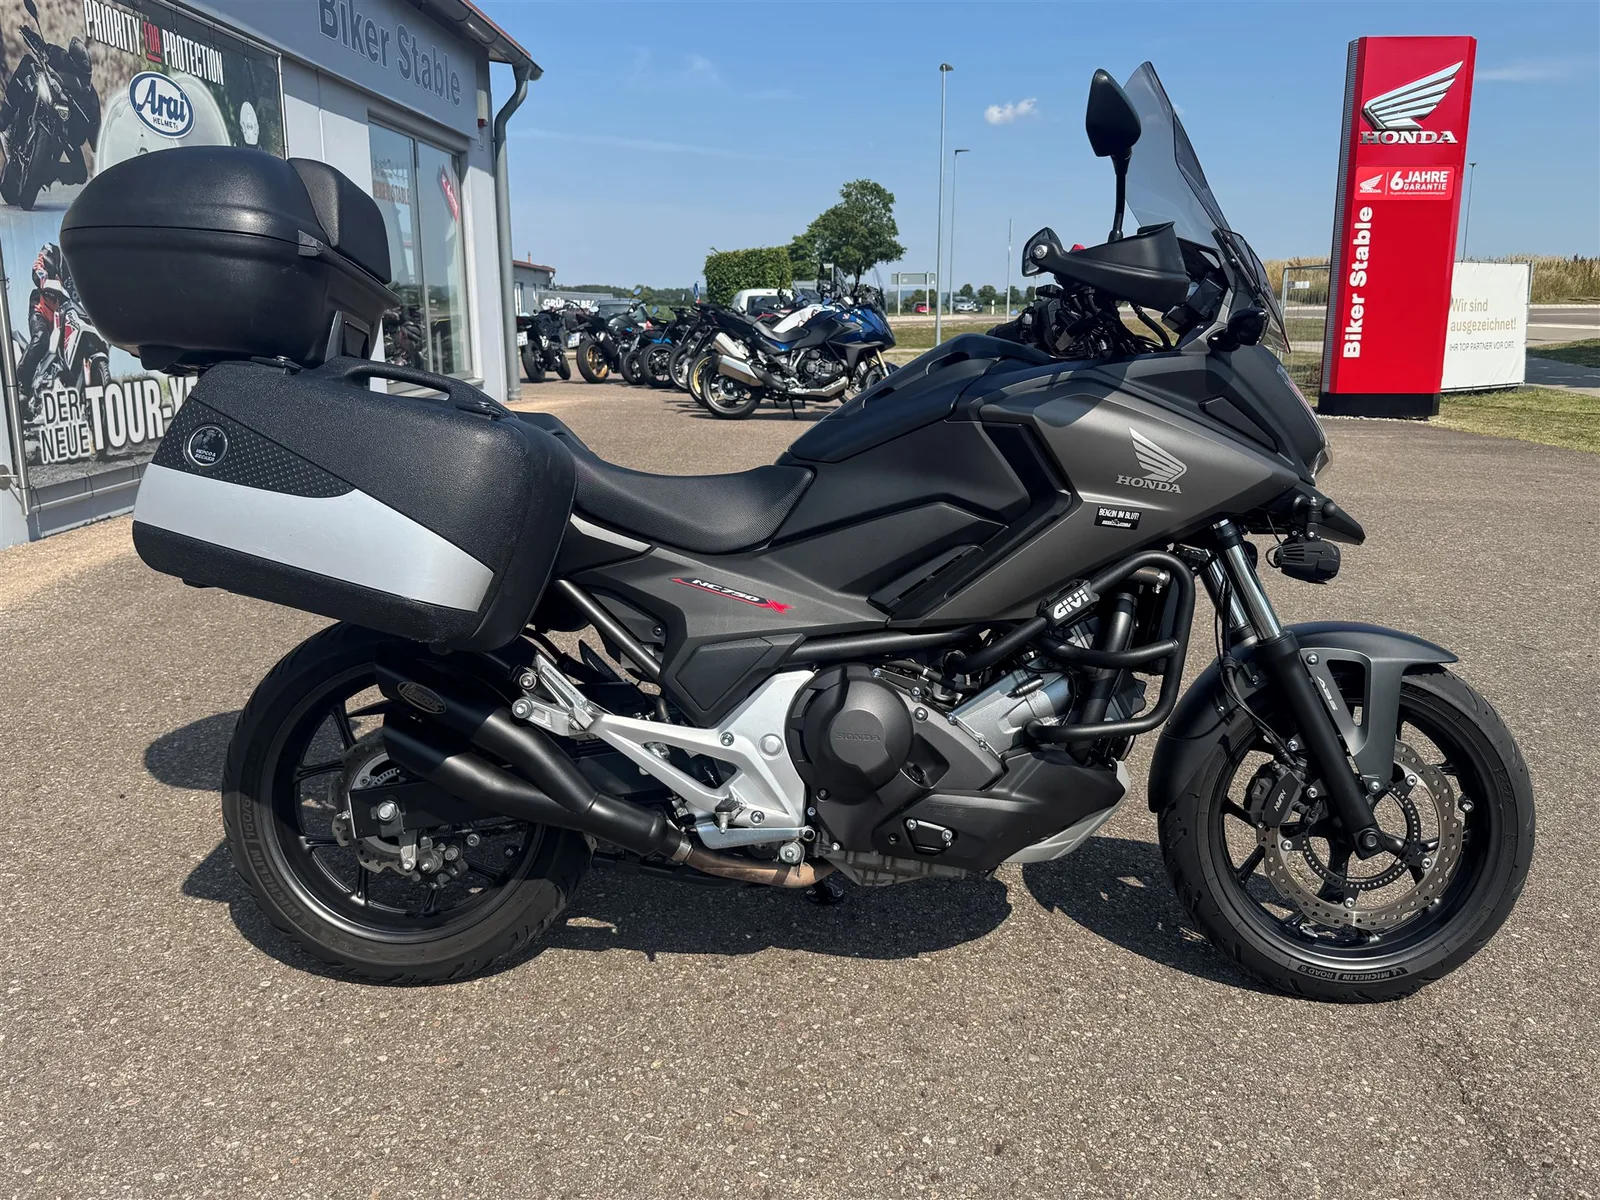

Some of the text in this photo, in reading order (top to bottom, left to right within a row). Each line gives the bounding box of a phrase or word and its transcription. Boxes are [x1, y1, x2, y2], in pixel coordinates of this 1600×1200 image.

[83, 0, 224, 86] PRIORITY FOR PROTECTION
[318, 0, 462, 107] Biker Stable
[136, 79, 187, 122] Arai
[1359, 130, 1458, 145] HONDA
[1390, 171, 1450, 190] 6 JAHRE
[1403, 183, 1447, 191] GARANTIE
[1349, 206, 1373, 287] Stable
[1469, 298, 1488, 312] sind
[1343, 293, 1365, 358] Biker
[1450, 317, 1517, 335] ausgezeichnet!
[42, 387, 80, 425] DER
[40, 421, 91, 464] NEUE
[1115, 474, 1182, 494] HONDA
[1053, 589, 1090, 619] GIVI
[834, 732, 882, 742] HONDA
[249, 849, 301, 919] MICHELIN
[1308, 968, 1334, 979] ROAD
[1341, 972, 1390, 981] MICHELIN
